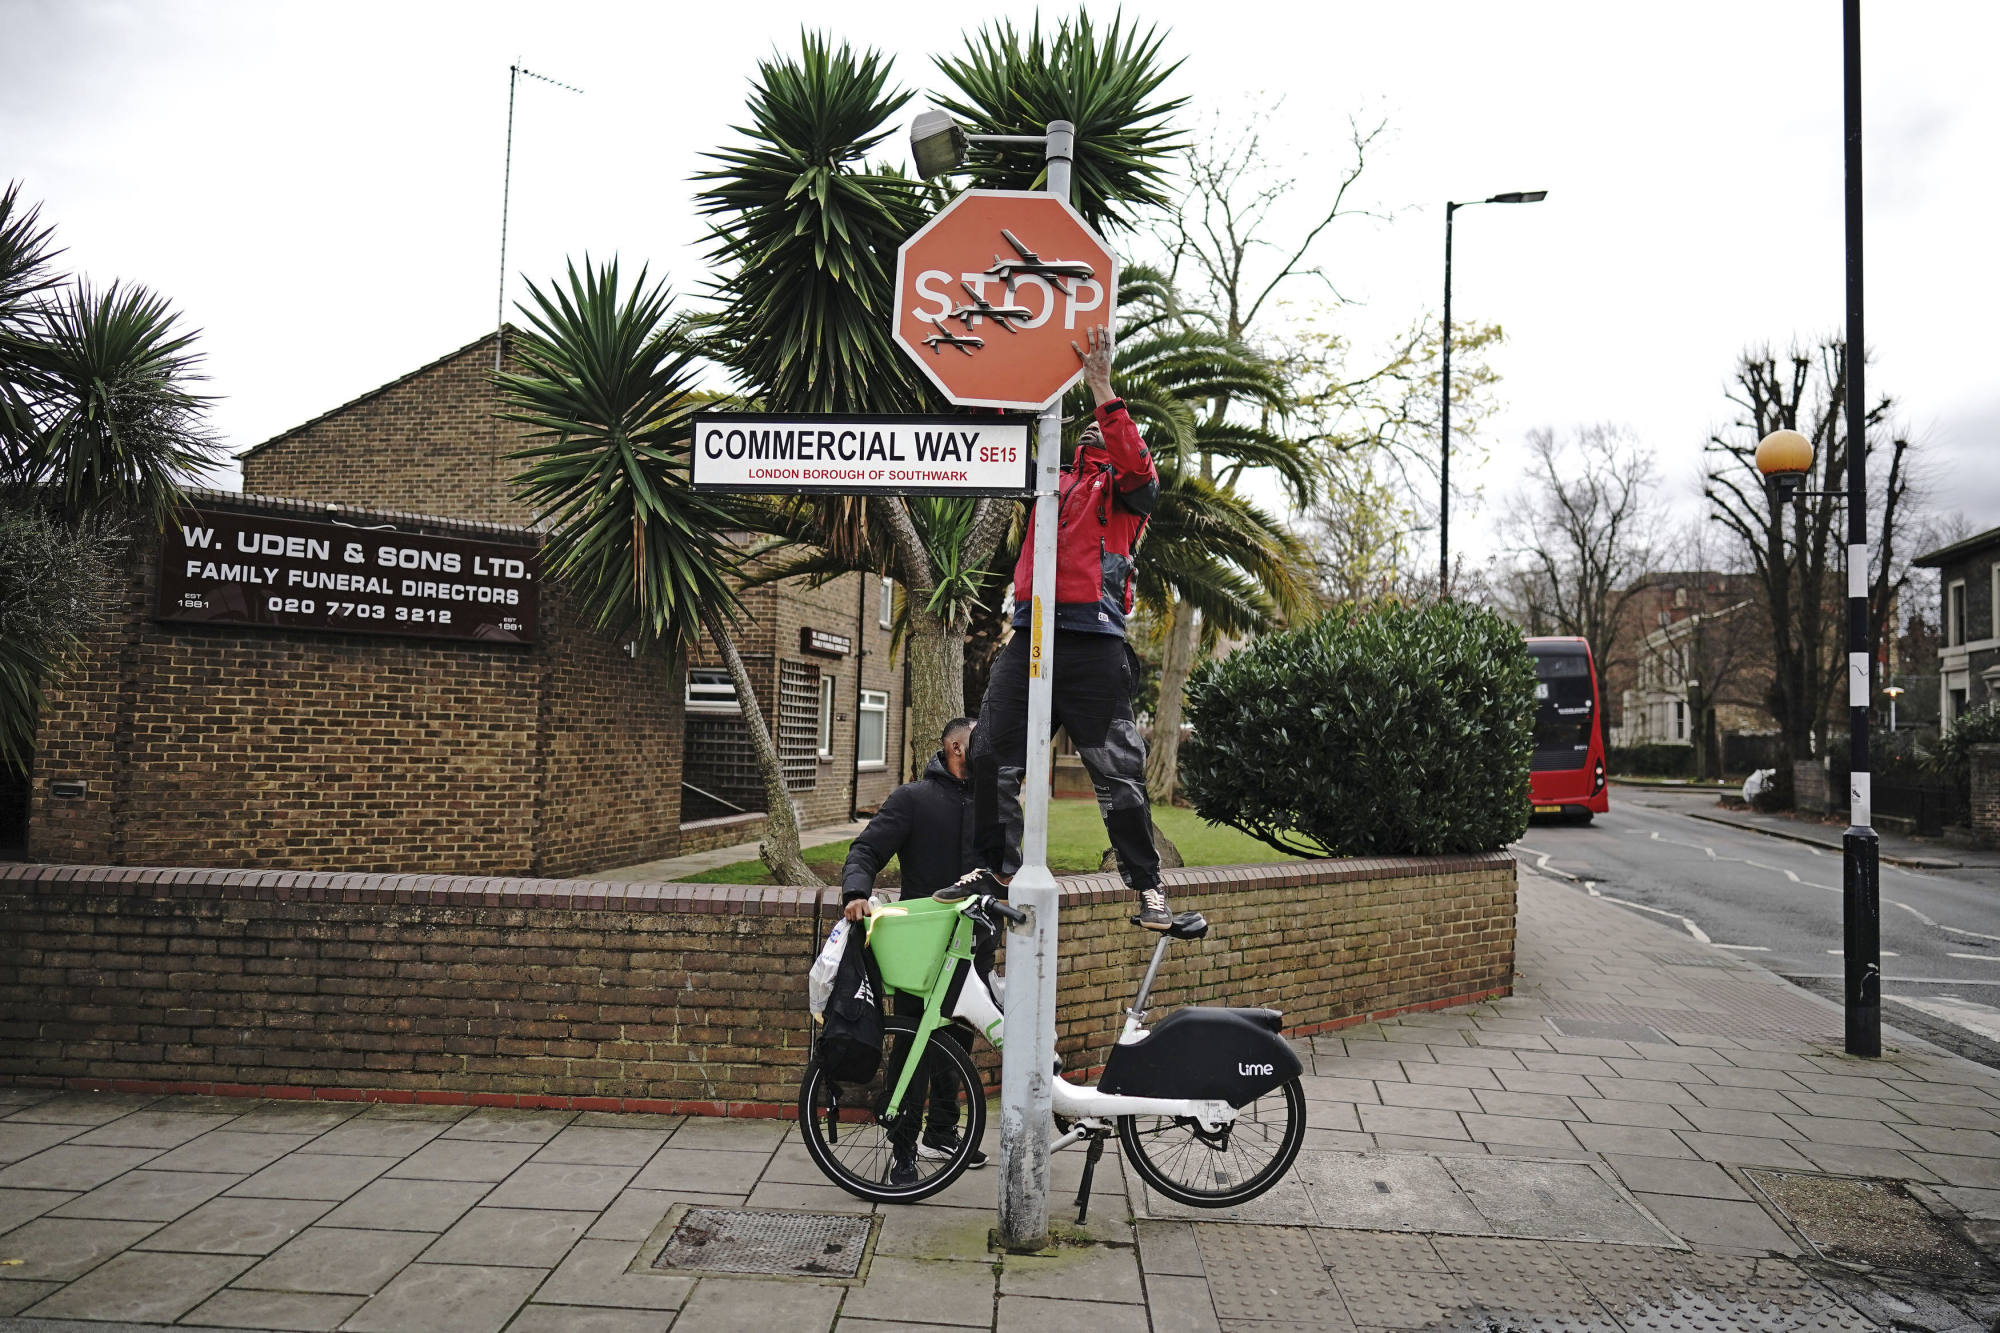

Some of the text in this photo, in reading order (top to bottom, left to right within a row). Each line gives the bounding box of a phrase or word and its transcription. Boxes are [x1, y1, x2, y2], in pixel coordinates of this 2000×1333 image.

[912, 270, 1104, 330] STOP
[705, 429, 1017, 463] COMMERCIAL WAY SE15
[748, 468, 968, 481] LONDON BOROUGH OF SOUTHWARK
[182, 525, 532, 580] W. UDEN & SONS LTD.
[186, 560, 519, 605] FAMILY FUNERAL DIRECTORS
[177, 599, 209, 609] 1881
[268, 597, 452, 624] 020 7703 3212
[1032, 646, 1040, 658] 3
[1032, 664, 1037, 676] 1
[1238, 1062, 1274, 1076] Lime
